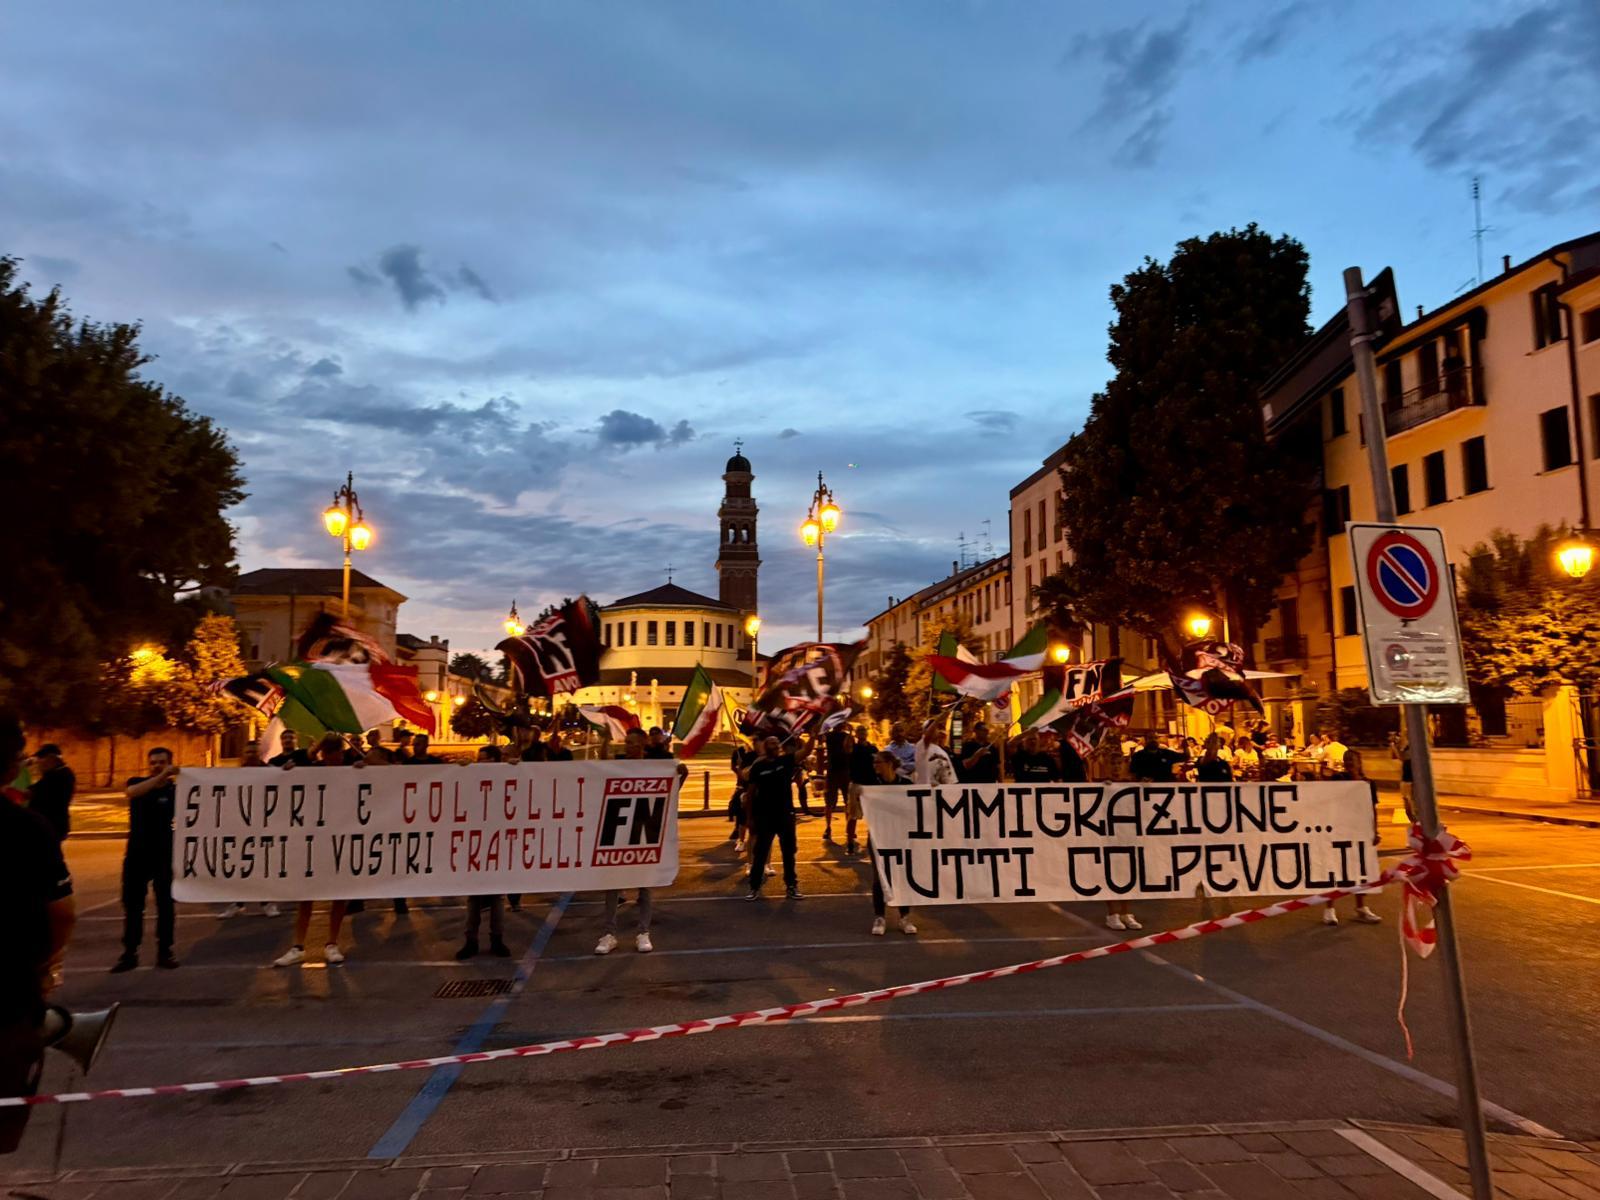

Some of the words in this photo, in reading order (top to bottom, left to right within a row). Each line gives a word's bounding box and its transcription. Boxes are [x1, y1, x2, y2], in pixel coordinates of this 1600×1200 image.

[1068, 663, 1101, 699] FN
[357, 784, 372, 825] E
[403, 777, 585, 824] COLTELLI
[609, 779, 668, 793] FORZA
[599, 797, 666, 847] FN
[907, 785, 1333, 839] IMMIGRAZIONE...
[305, 835, 314, 877] I
[332, 831, 434, 875] VOSTRI
[451, 826, 584, 872] FRATELLI
[595, 850, 658, 865] NUOVA
[878, 847, 1036, 899] TUTTI
[1067, 841, 1368, 895] COLPEVOLI!
